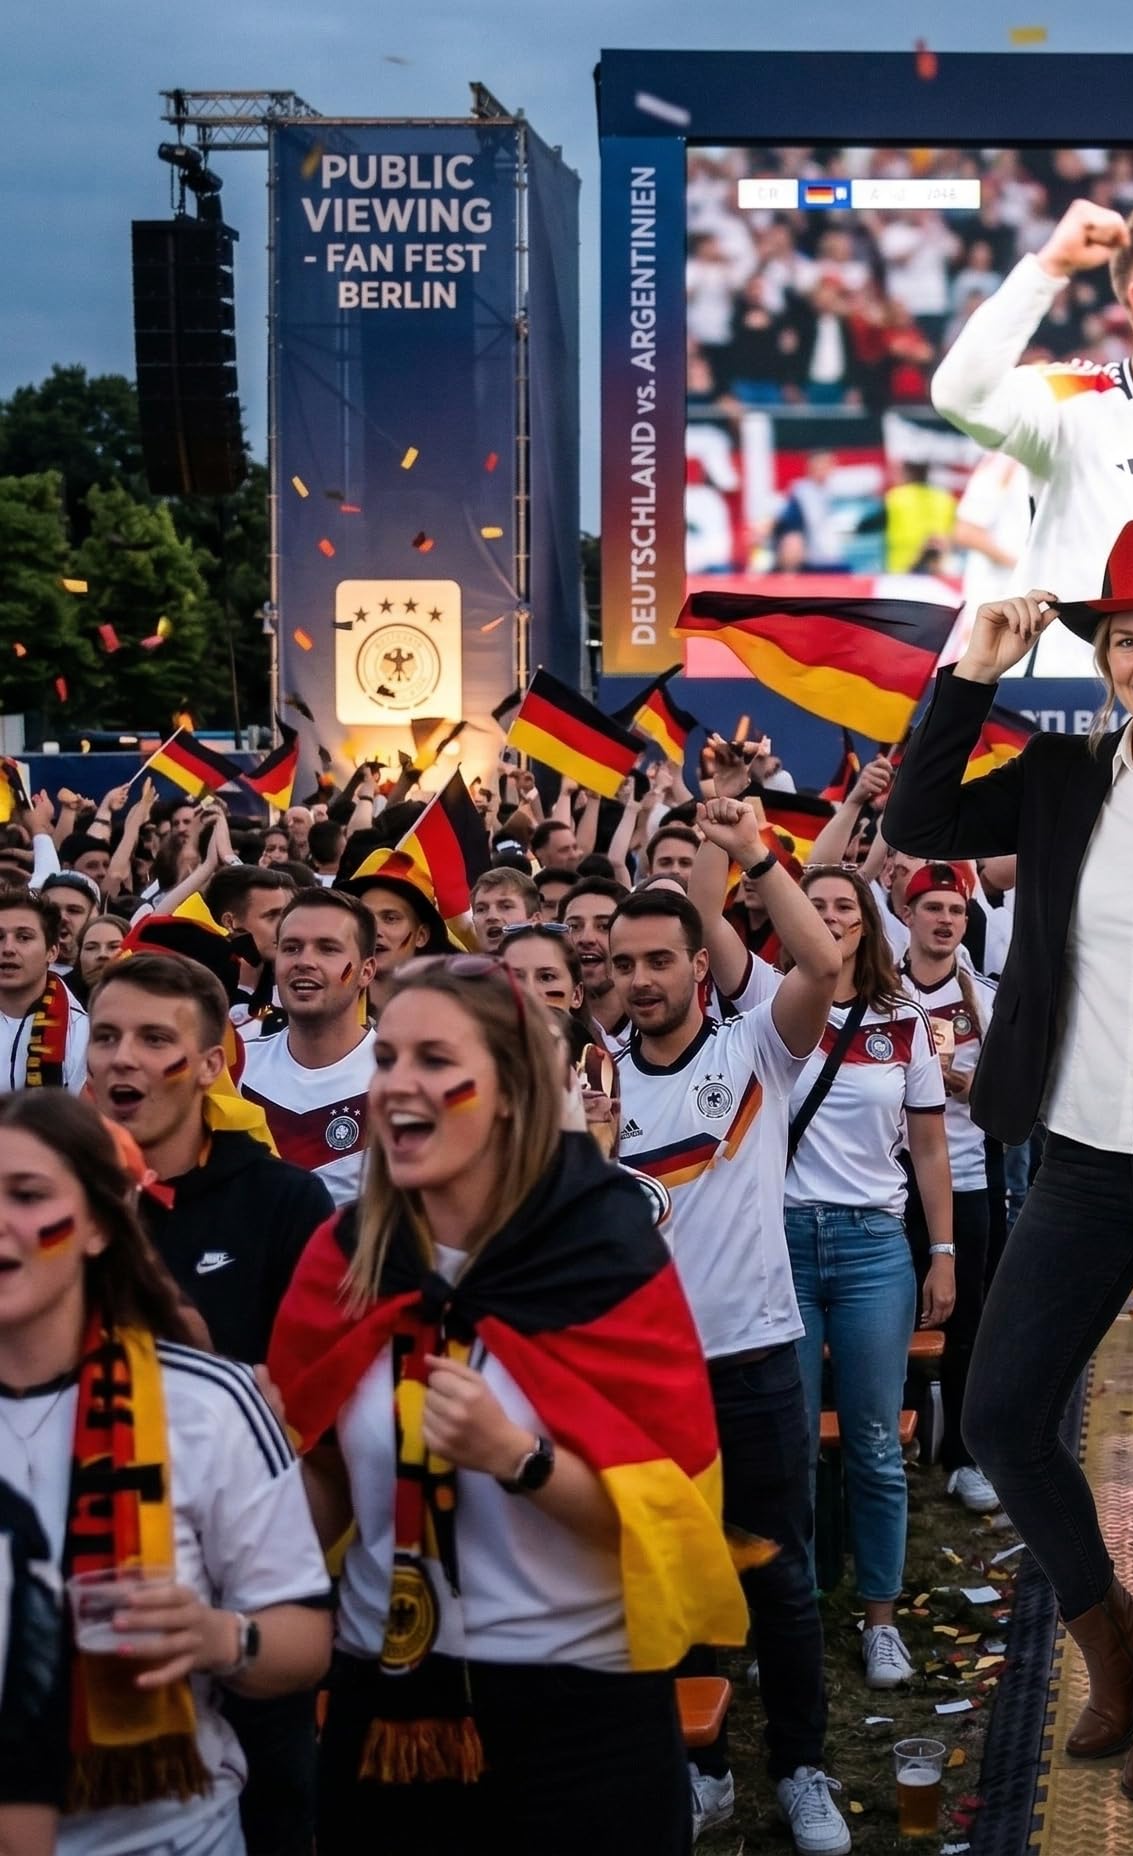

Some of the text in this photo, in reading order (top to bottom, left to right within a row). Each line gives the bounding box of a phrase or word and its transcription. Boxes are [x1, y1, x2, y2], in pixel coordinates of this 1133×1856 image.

[321, 154, 474, 190] PUBLIC
[301, 197, 493, 234] VIEWING
[326, 243, 394, 273] FAN
[405, 243, 487, 273] FEST
[338, 280, 457, 309] BERLIN
[630, 167, 657, 646] DEUTSCHLAND vs. ARGENTINIEN
